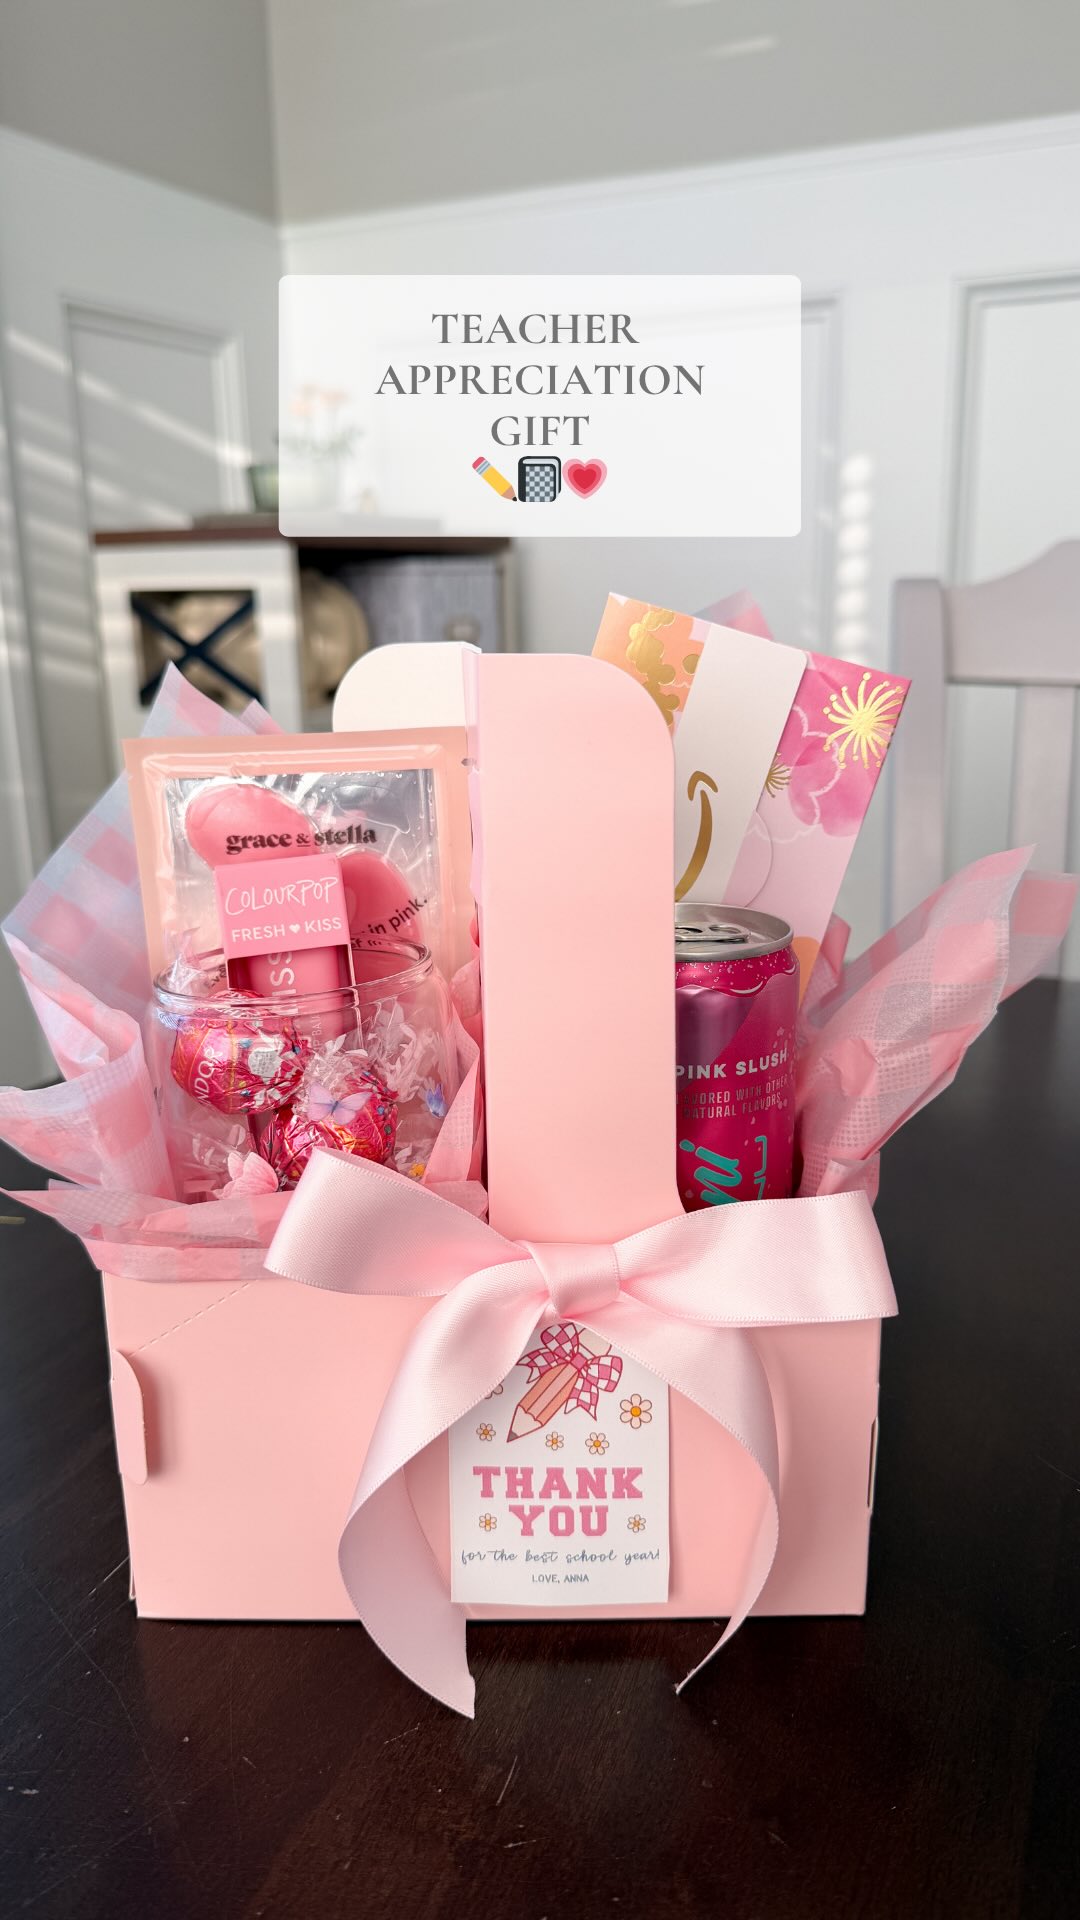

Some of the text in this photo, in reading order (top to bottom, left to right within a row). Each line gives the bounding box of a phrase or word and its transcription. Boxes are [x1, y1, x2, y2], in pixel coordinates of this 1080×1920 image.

[225, 824, 377, 855] grace & stella
[225, 877, 338, 916] COLOURPOP
[368, 896, 427, 934] in pink.
[231, 917, 343, 943] FRESH KISS
[735, 1048, 787, 1076] SLUSH
[684, 1092, 781, 1119] NATURAL FLAVORS
[736, 1085, 762, 1101] WITH
[472, 1465, 643, 1499] THANK
[508, 1504, 609, 1537] YOU
[461, 1548, 660, 1565] for the best school year!
[532, 1574, 590, 1584] LOVE, ANNA
